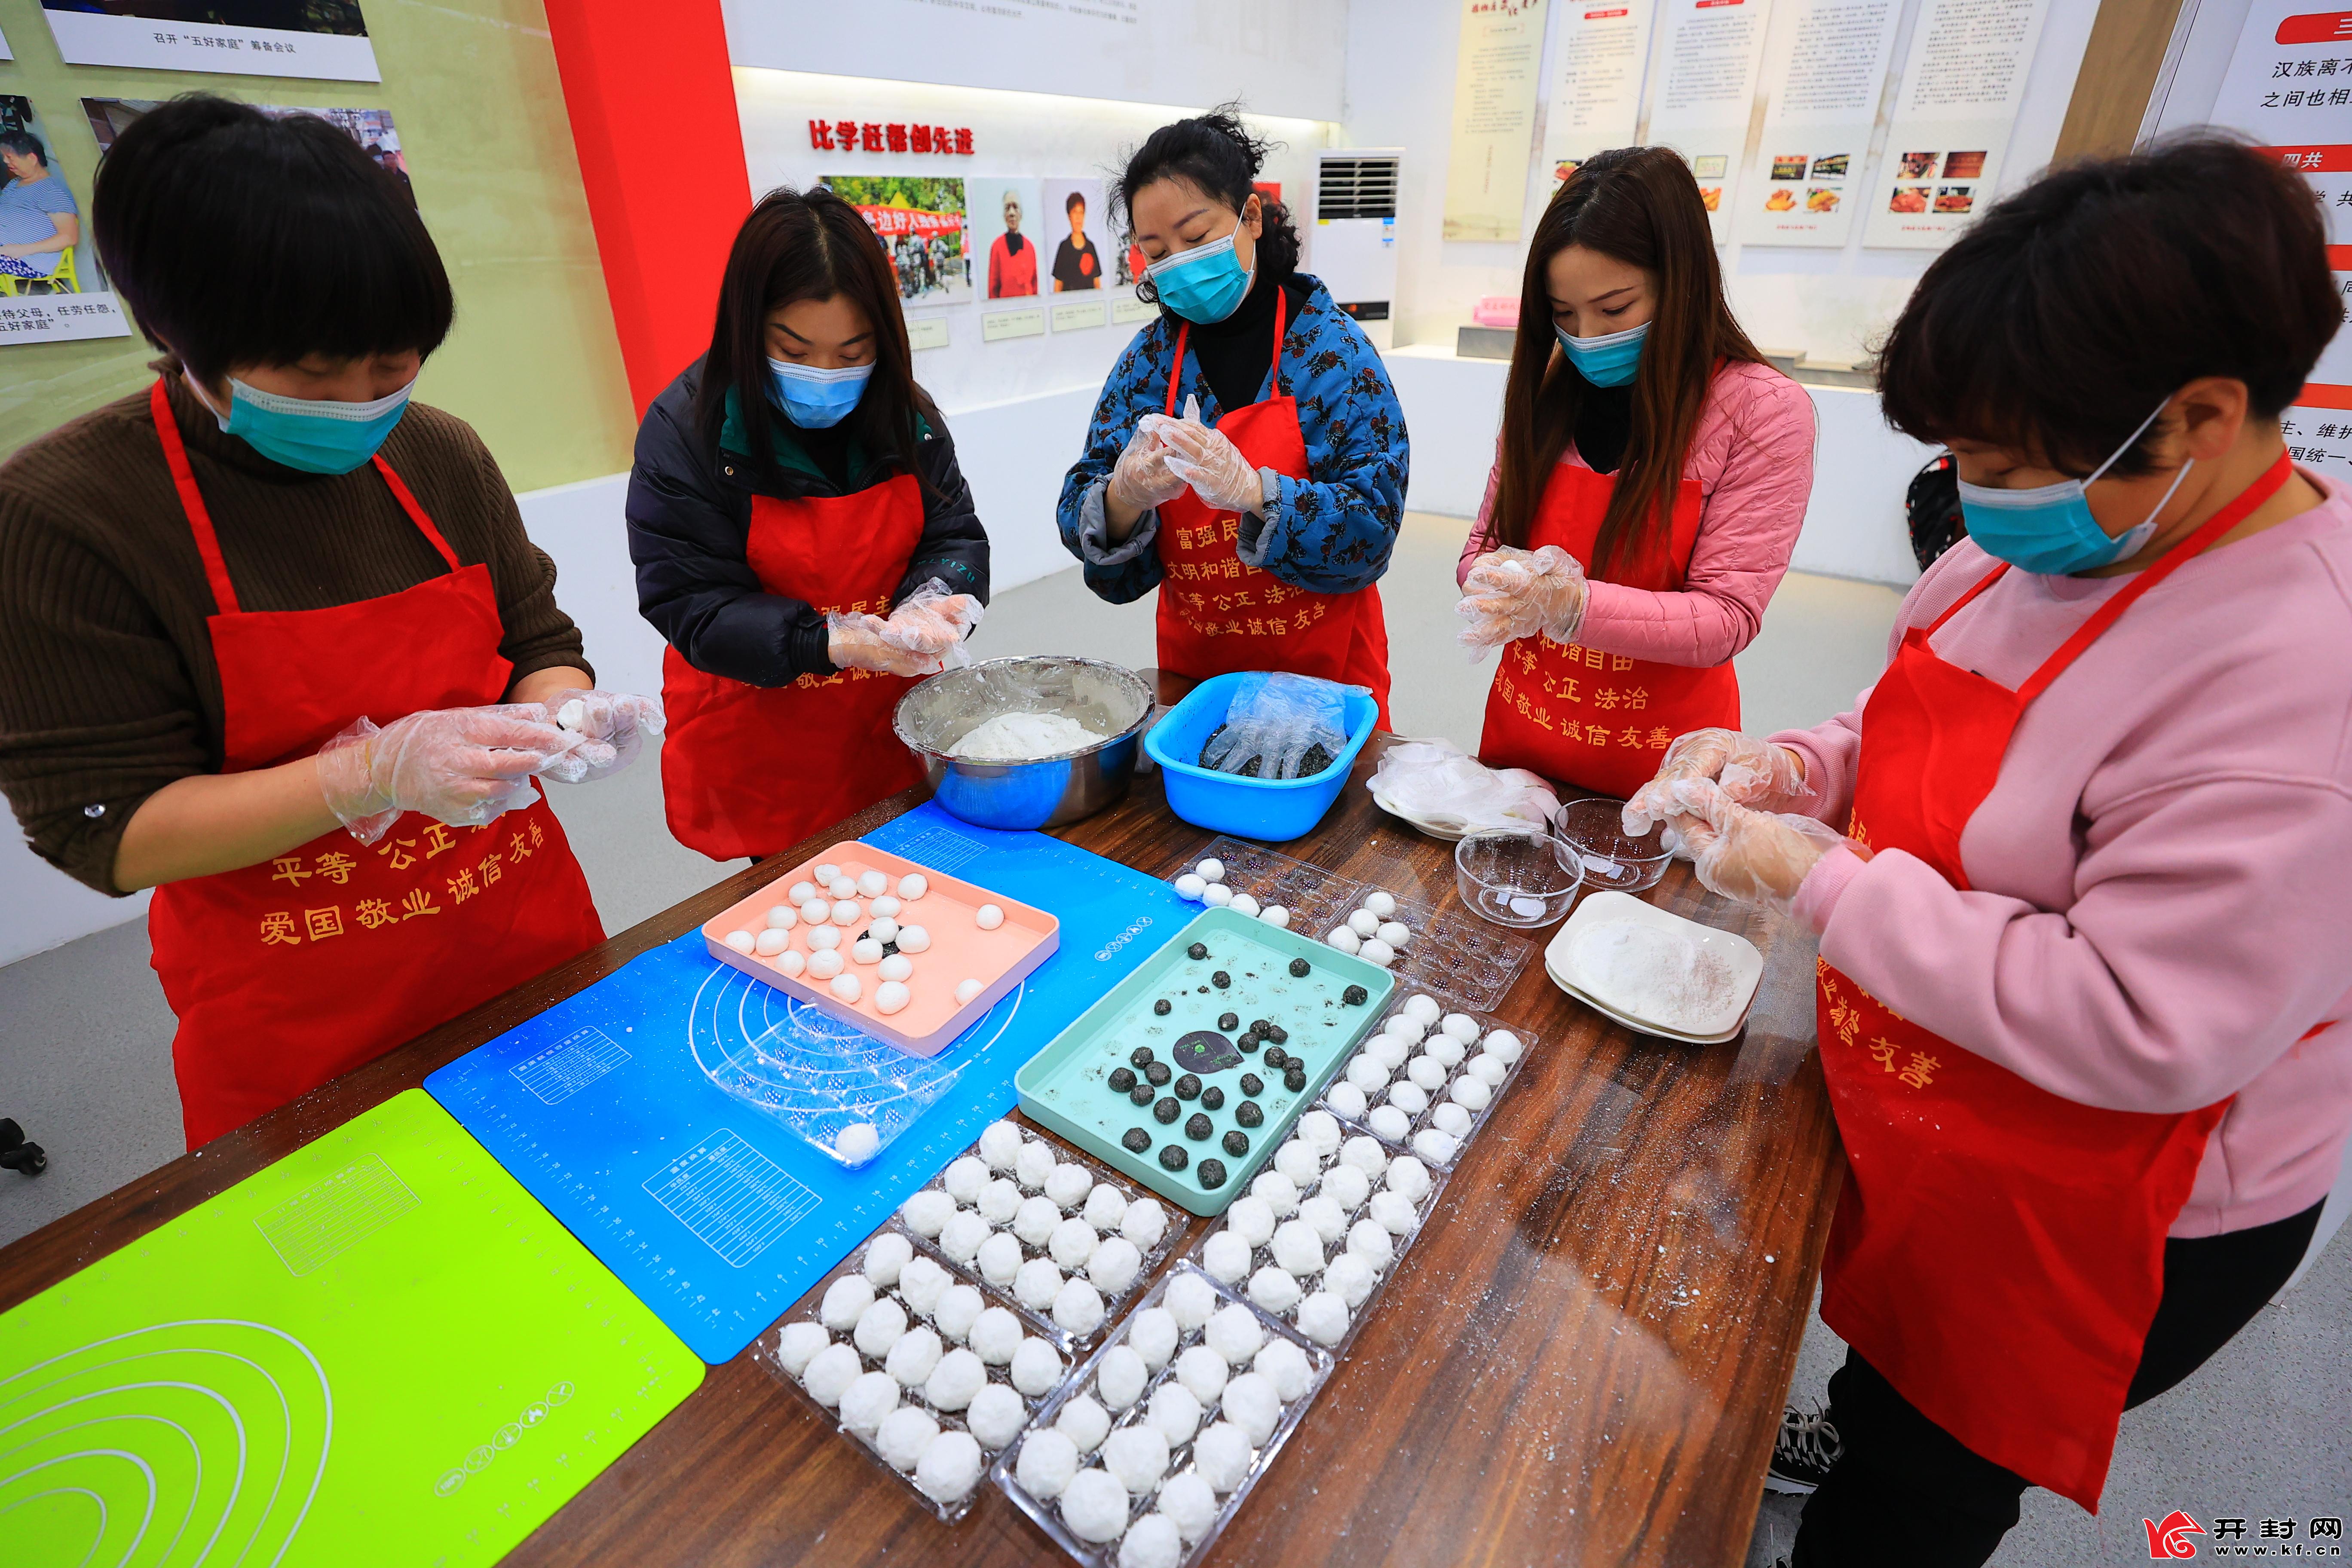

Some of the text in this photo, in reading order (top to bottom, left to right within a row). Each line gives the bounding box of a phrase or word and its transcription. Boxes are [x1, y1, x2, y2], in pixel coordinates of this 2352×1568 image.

[2260, 89, 2352, 108] 之间也相
[809, 119, 974, 154] 比学赶帮创先进
[1247, 618, 1287, 636] 诚信
[1595, 686, 1648, 710] 法治
[1560, 717, 1611, 747] 诚信
[1617, 725, 1672, 749] 友善
[272, 823, 456, 887] 平等 公正
[260, 905, 343, 945] 爱国
[355, 888, 441, 929] 敬业
[447, 853, 502, 904] 诚信
[1868, 1037, 1941, 1089] 友善
